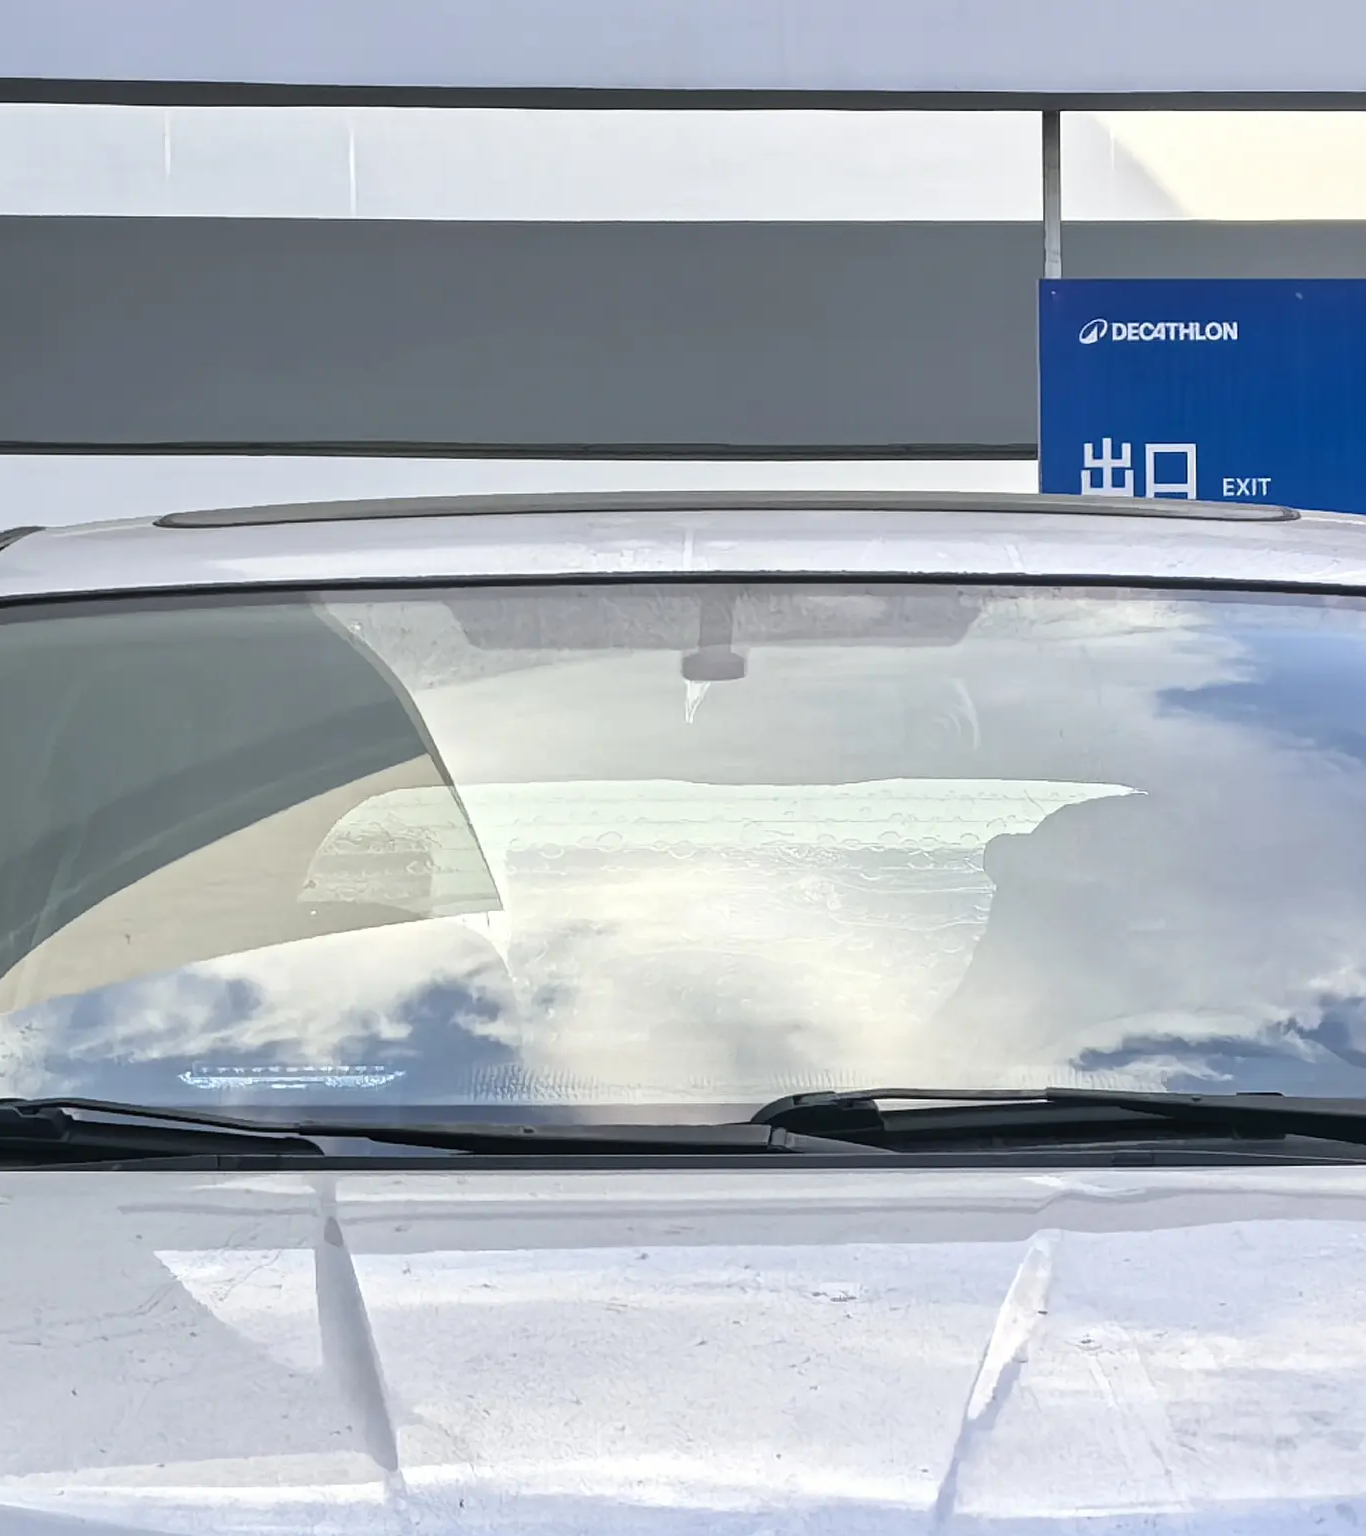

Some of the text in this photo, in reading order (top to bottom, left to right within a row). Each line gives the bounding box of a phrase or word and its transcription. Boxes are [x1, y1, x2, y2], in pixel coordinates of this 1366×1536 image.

[1111, 321, 1238, 341] DECATHLON
[1081, 438, 1197, 500] 出口
[1222, 477, 1272, 497] EXIT
